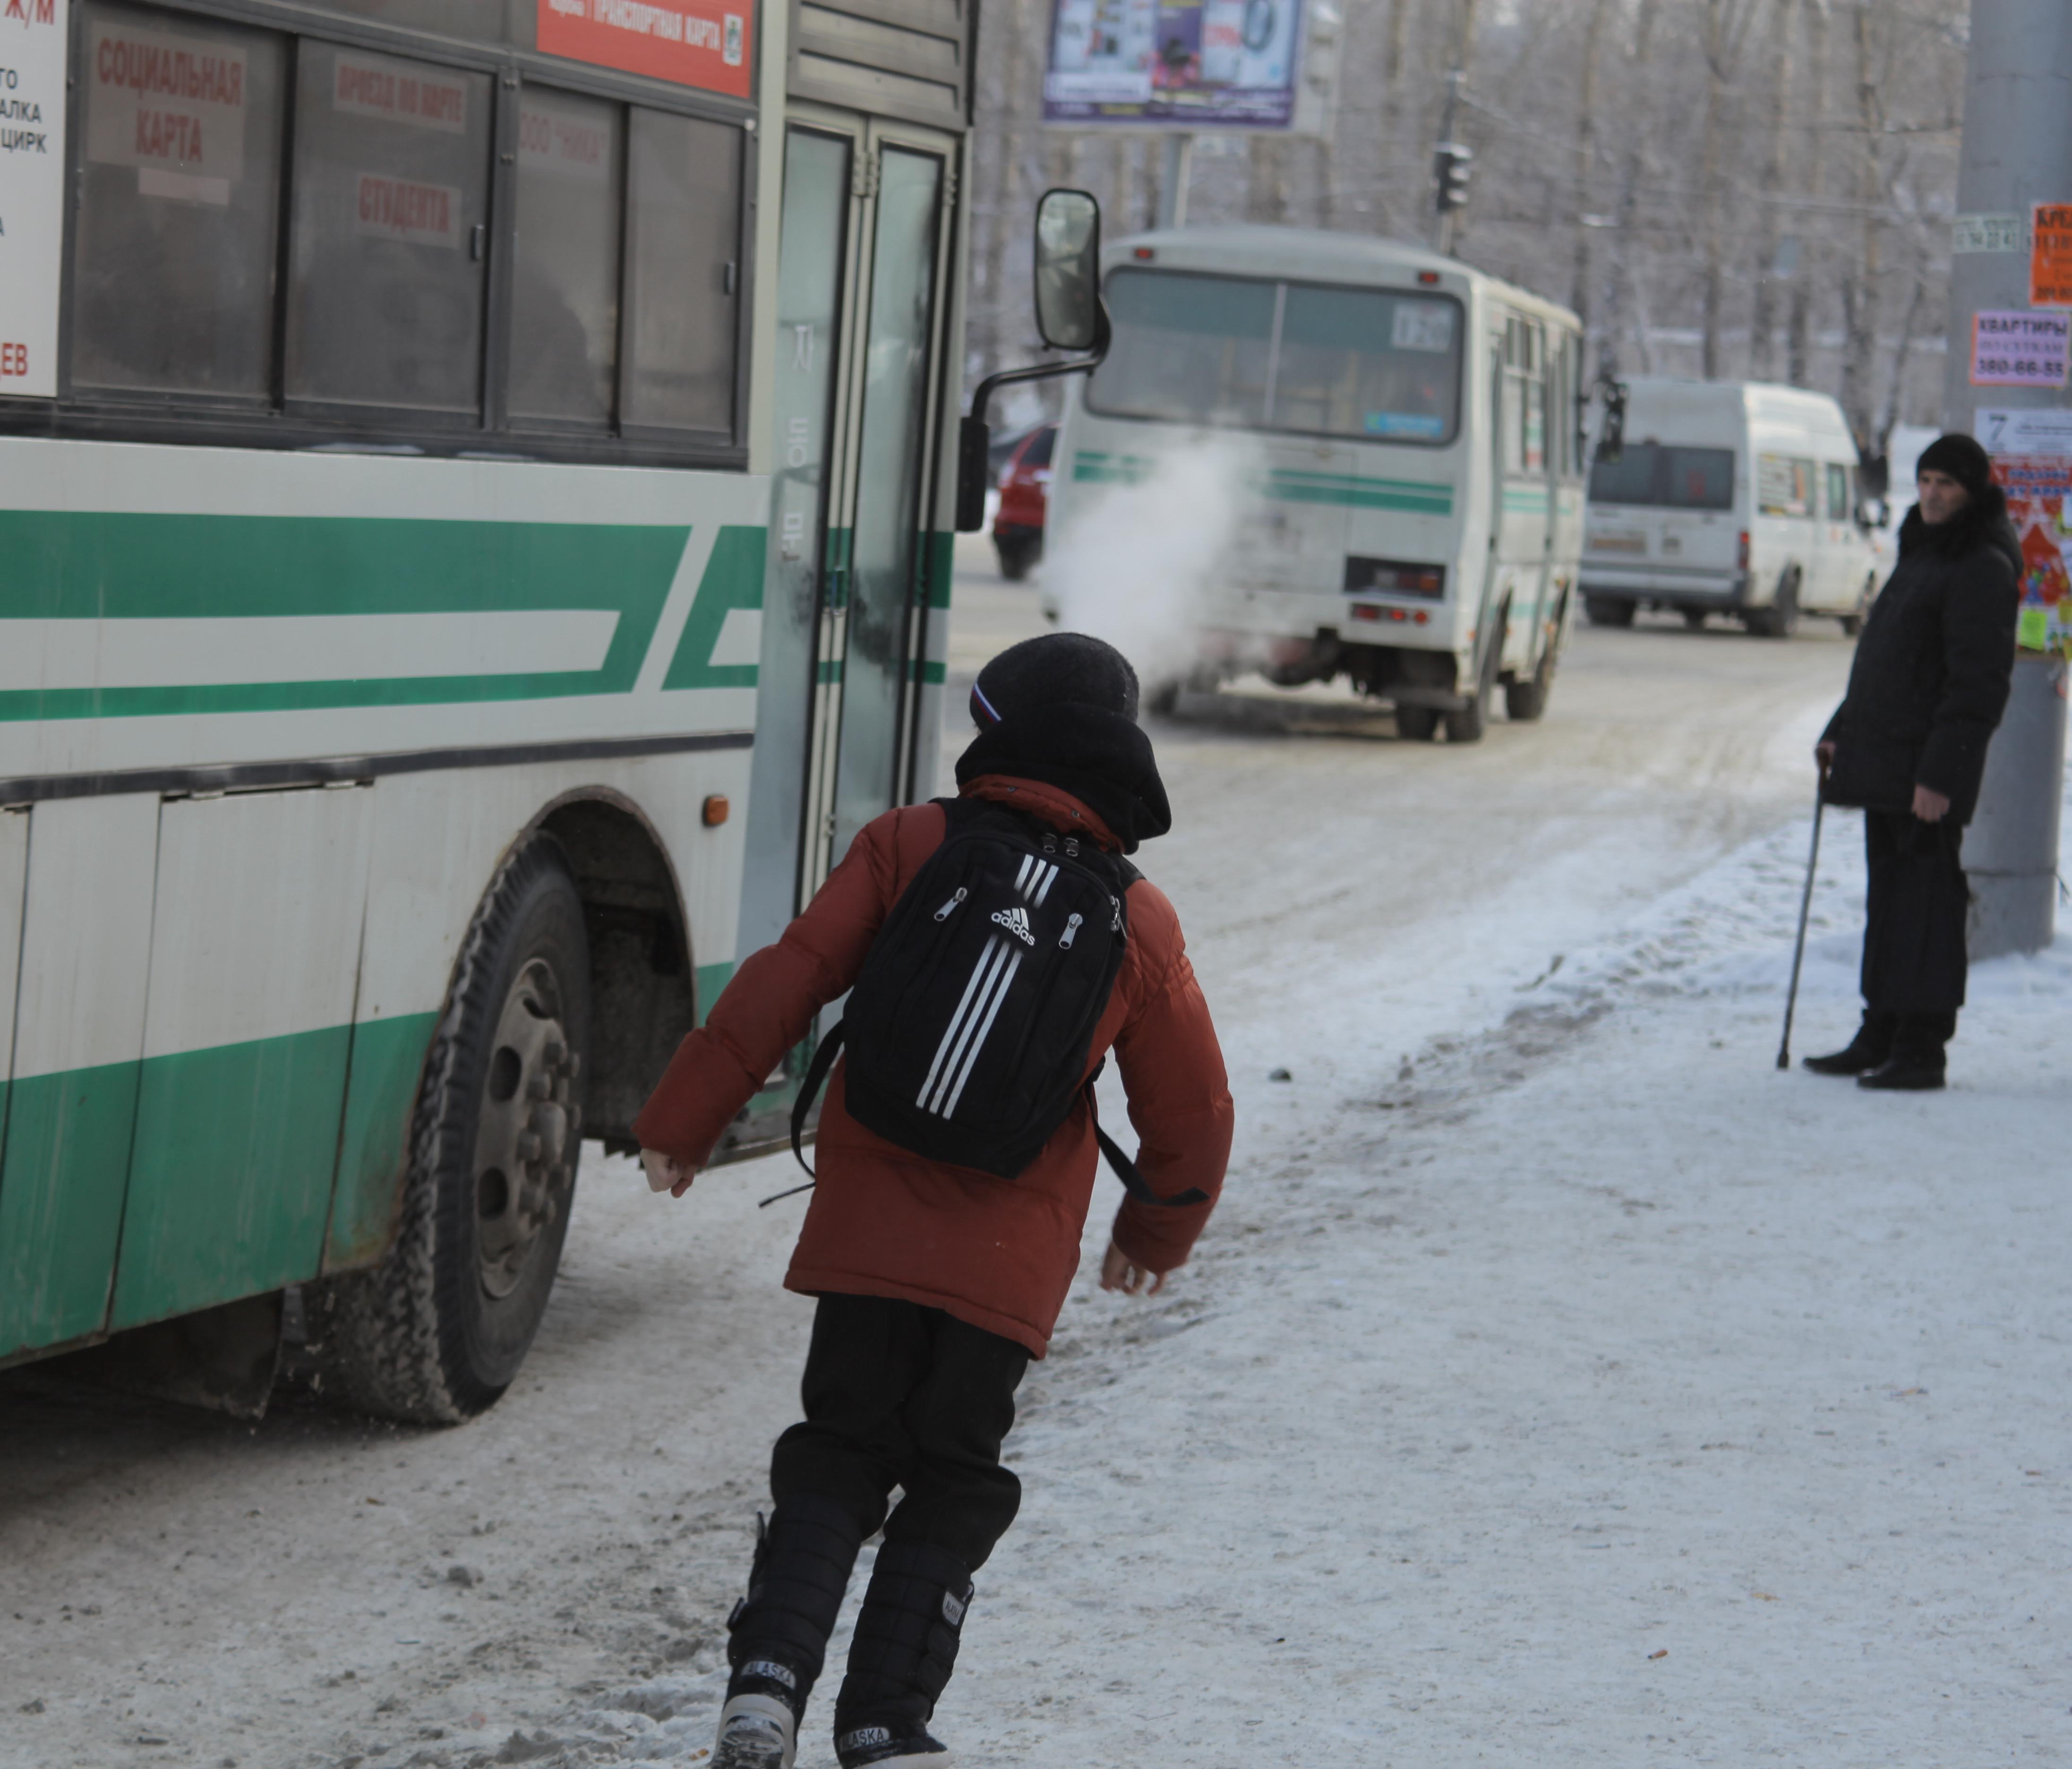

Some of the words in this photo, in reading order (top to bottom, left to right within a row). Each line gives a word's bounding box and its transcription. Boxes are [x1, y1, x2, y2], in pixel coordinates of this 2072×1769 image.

[685, 15, 721, 51] КАРТА
[98, 37, 242, 107] СОЦИАЛЬНАЯ
[338, 65, 395, 115] ПРОЕЗД
[399, 77, 418, 114] ПО
[421, 82, 462, 122] КАРТЕ
[1, 128, 47, 154] ЦИРК
[136, 108, 203, 163] КАРТА
[359, 176, 450, 234] СТУДЕНТА
[1979, 318, 2068, 337] КВАРТИРЫ
[991, 912, 1035, 946] adidas
